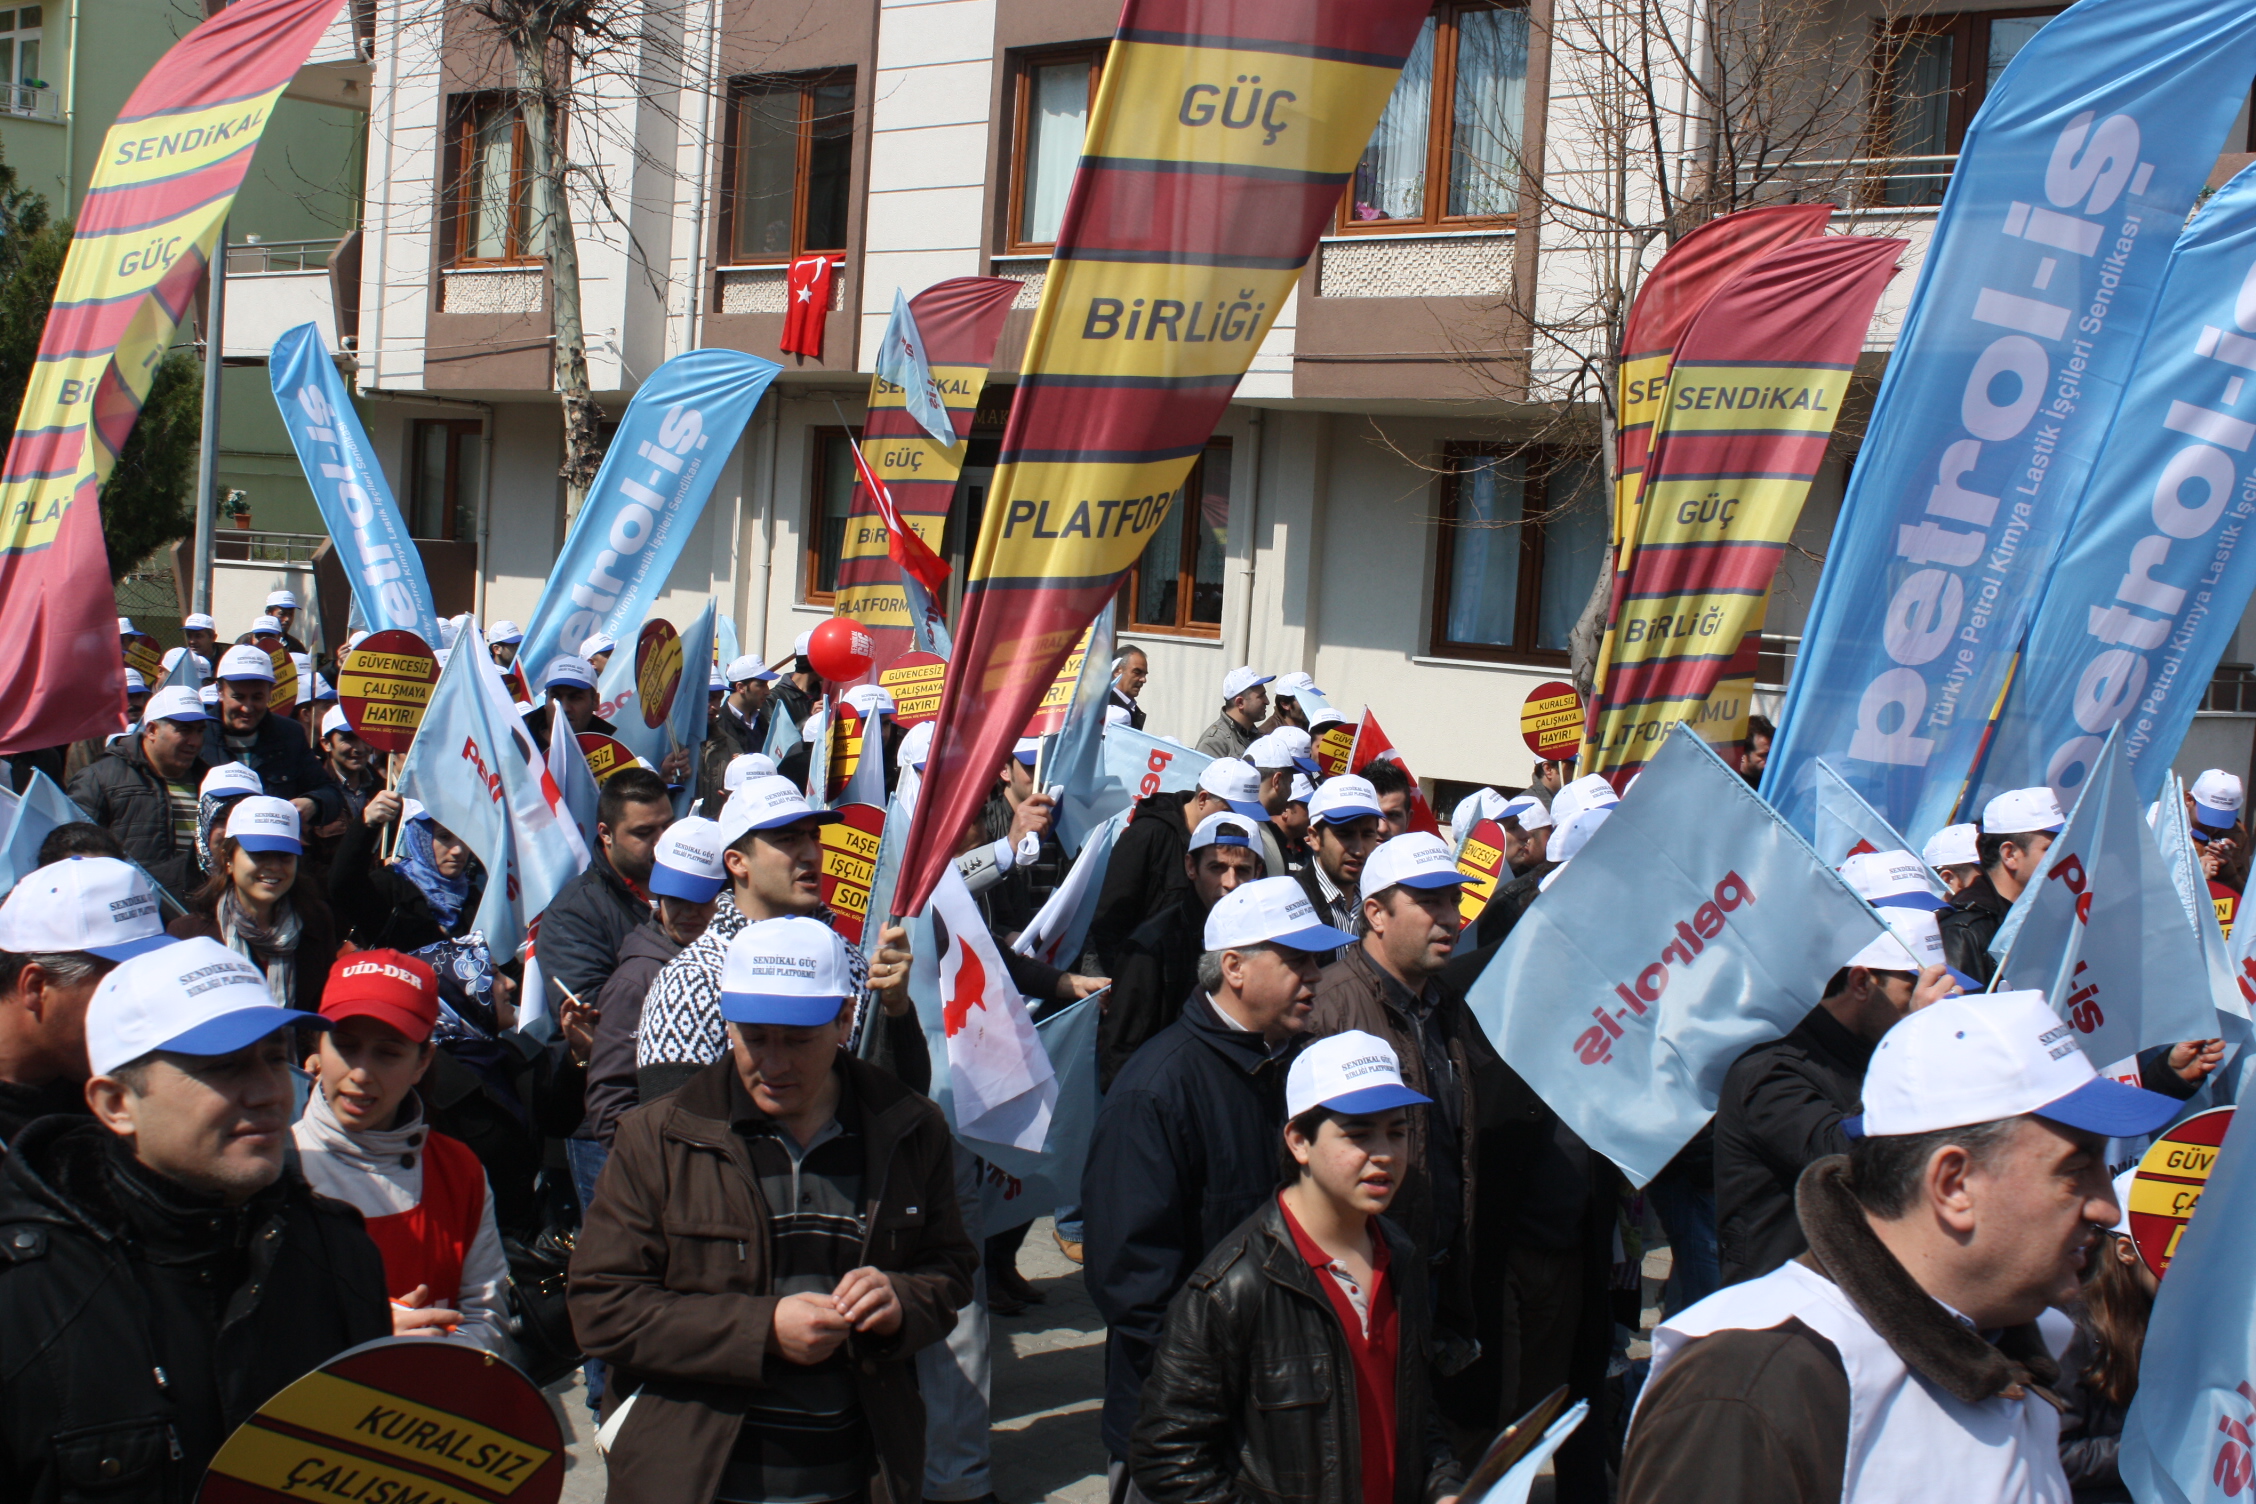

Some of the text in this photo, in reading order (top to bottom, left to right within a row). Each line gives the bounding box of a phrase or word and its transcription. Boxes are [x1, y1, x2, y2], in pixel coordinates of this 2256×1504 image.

[1178, 75, 1296, 146] GÜÇ
[118, 236, 182, 280] GÜÇ
[1847, 111, 2155, 767] petrol-iş
[884, 447, 925, 472] GÜÇ
[1928, 214, 2143, 727] Türkiye Petrol Kimya Lastik İşçileri Sendikası
[299, 384, 420, 632] etrol-iş
[1002, 489, 1178, 540] PLATFOR
[1677, 493, 1739, 530] GÜÇ
[616, 584, 639, 622] Kimya
[635, 547, 660, 587] Lastik
[667, 457, 702, 514] Sendikası
[837, 597, 909, 617] PLATFORM
[2142, 651, 2181, 718] Petrol
[2173, 585, 2211, 650] Kimya
[2208, 522, 2242, 588] Lastik
[358, 653, 430, 675] GÜVENCESİZ
[889, 664, 943, 681] GÜVENCESİZ
[363, 681, 426, 699] ÇALIŞMAYA
[895, 683, 943, 699] ÇALIŞMAYA
[901, 699, 936, 713] HAYIR!
[1539, 696, 1575, 711] KURALSIZ
[366, 706, 415, 724] HAYIR!
[1535, 713, 1577, 729] ÇALIŞMAYA
[1541, 729, 1571, 745] HAYIR!
[846, 832, 880, 855] TAŞE
[1465, 843, 1497, 864] ENCESİZ
[753, 953, 817, 971] SENDİKAL GÜÇ
[776, 967, 816, 979] PLATFORMU
[342, 961, 422, 990] UİD-DER
[1341, 1055, 1380, 1071] SENDİKAL
[355, 1405, 534, 1483] KURALSIZ
